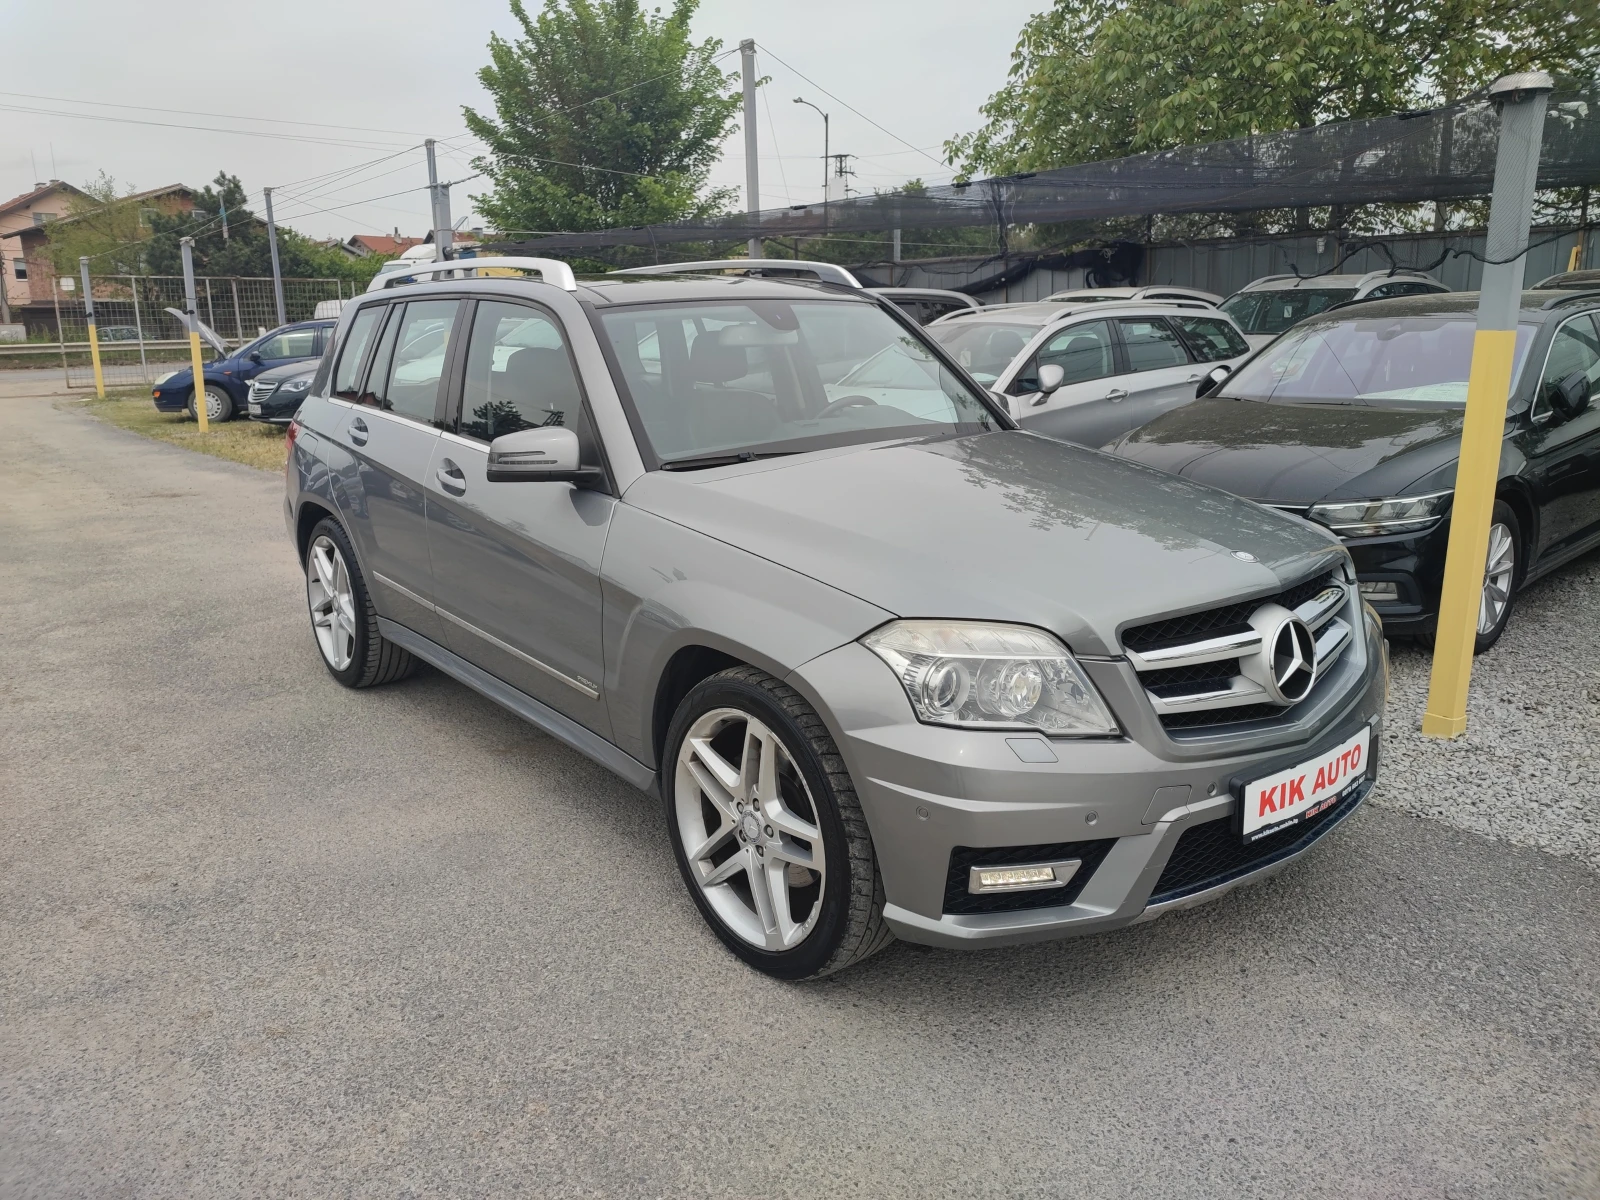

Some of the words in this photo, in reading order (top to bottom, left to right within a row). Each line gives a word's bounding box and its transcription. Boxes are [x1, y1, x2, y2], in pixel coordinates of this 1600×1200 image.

[1259, 774, 1306, 817] KIK
[1312, 744, 1361, 795] AUTO
[1305, 806, 1319, 819] KIK
[1319, 796, 1337, 811] AUTO
